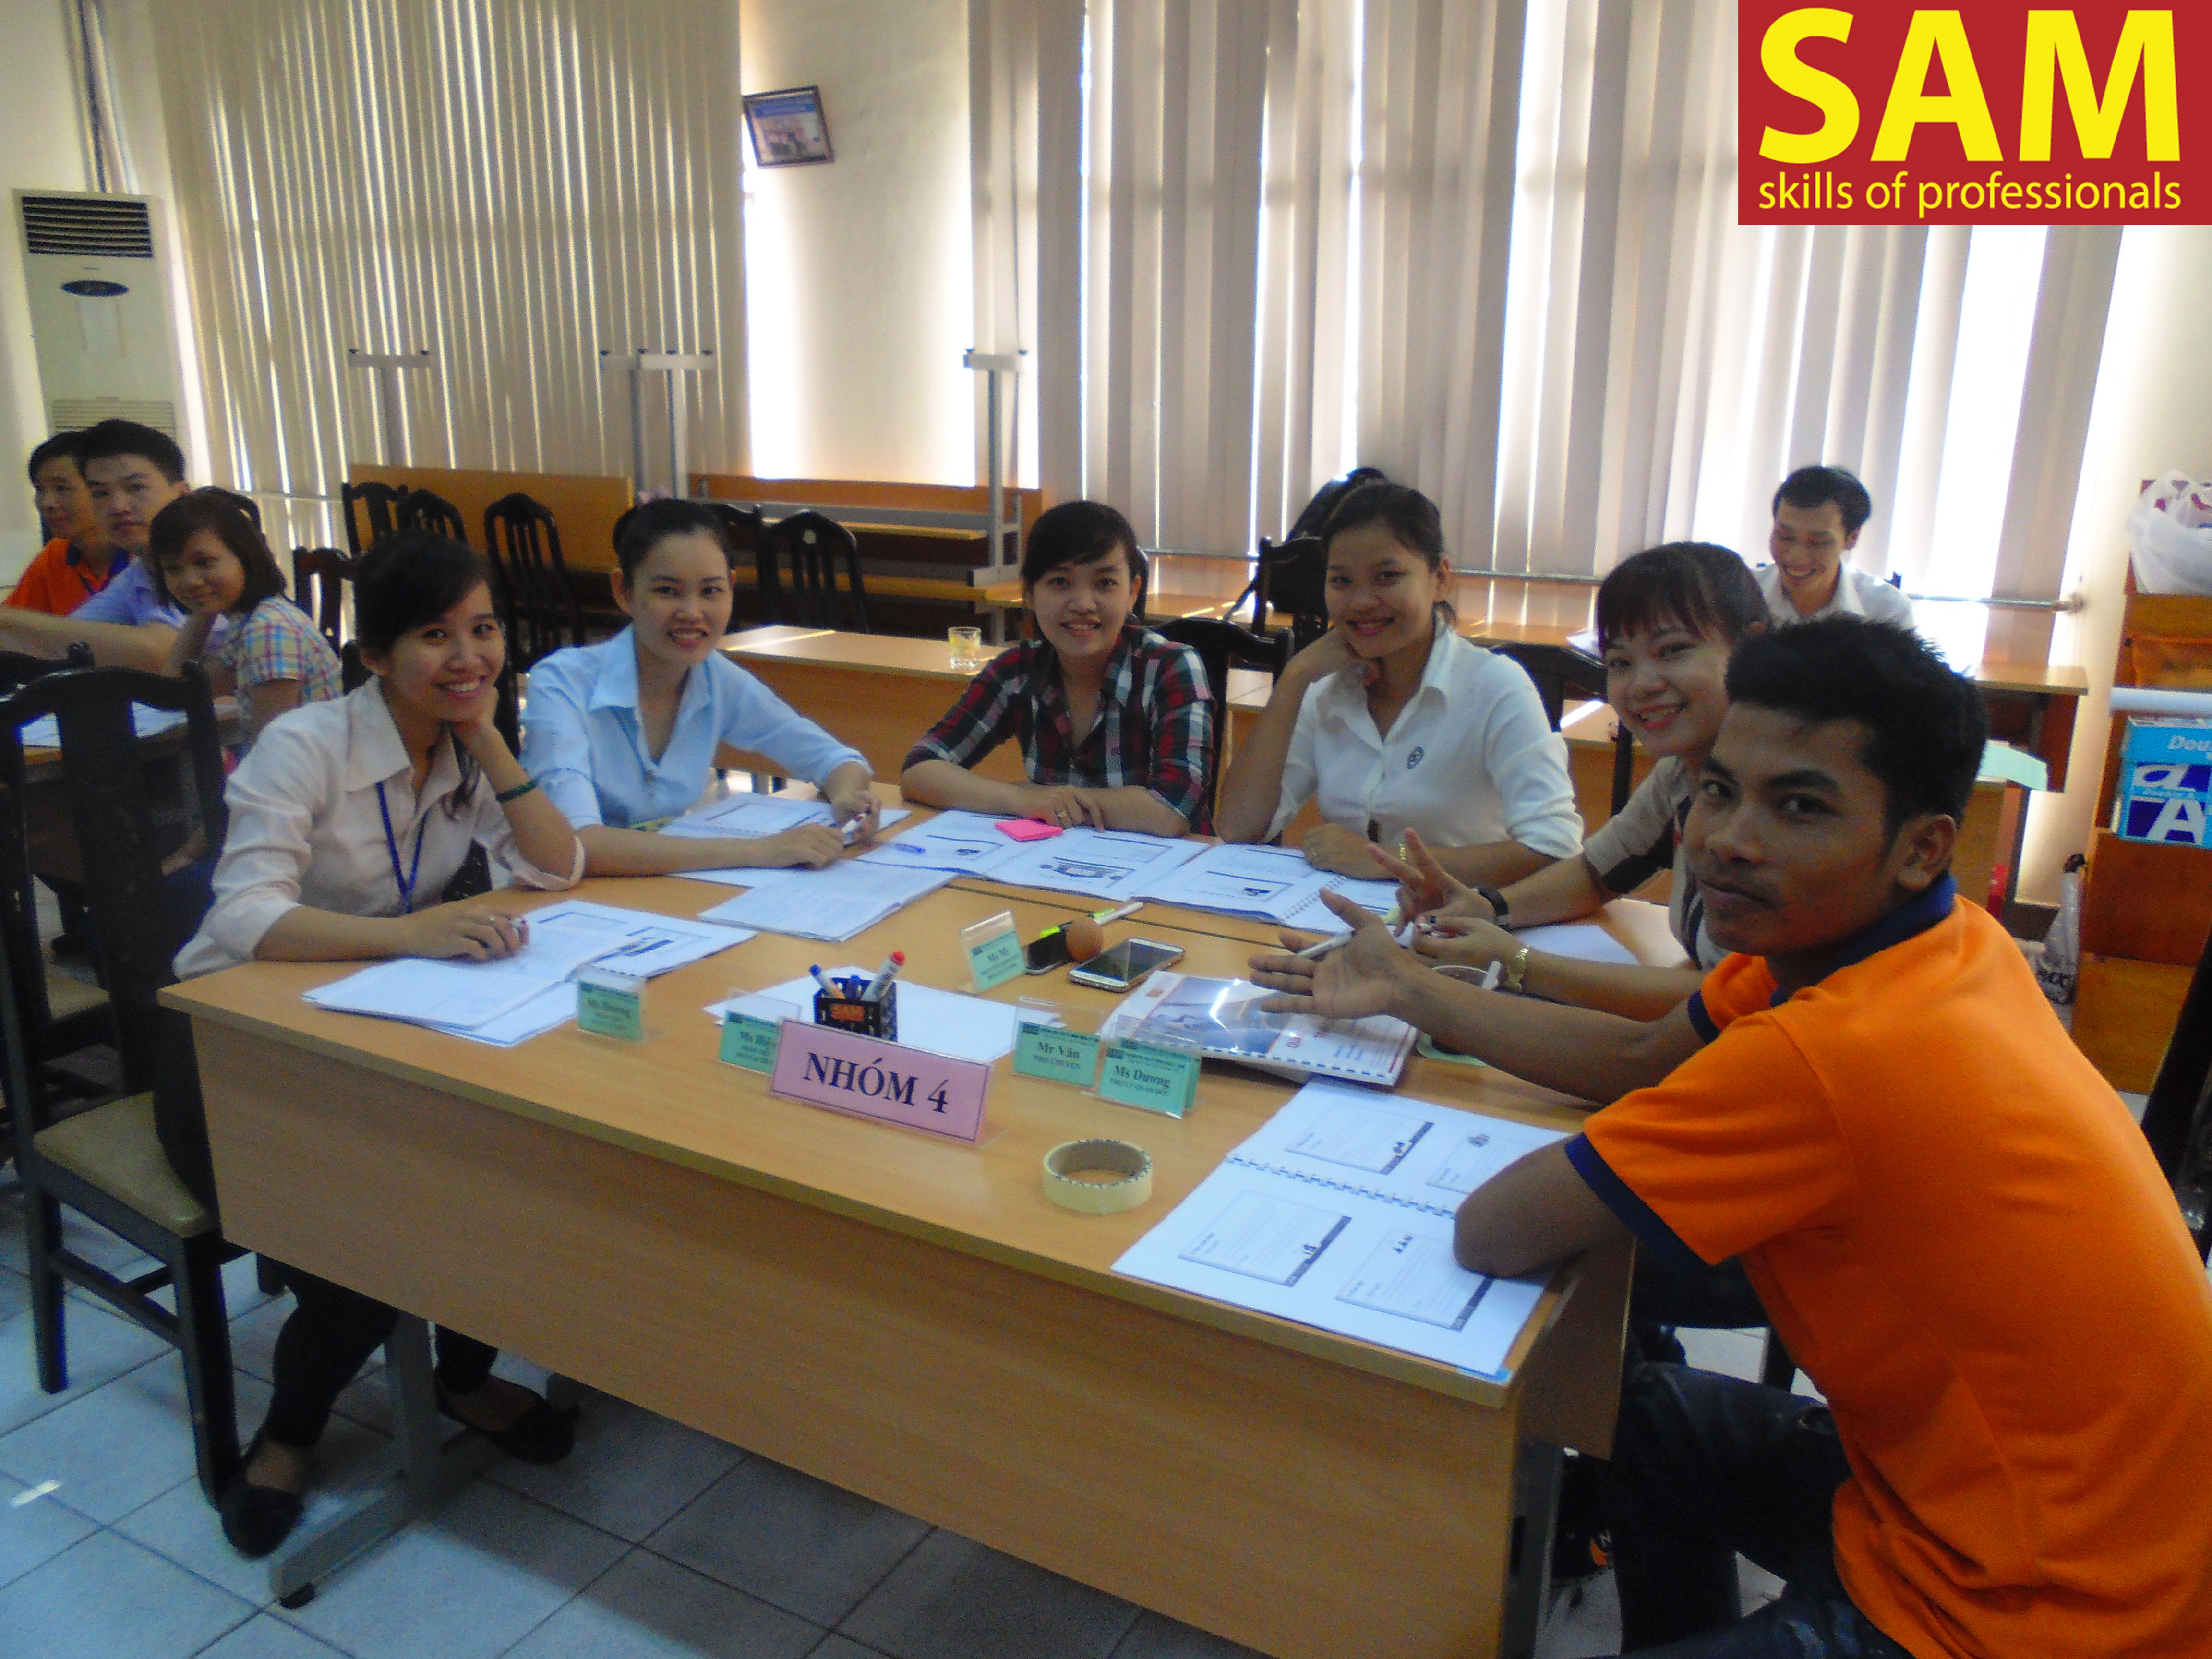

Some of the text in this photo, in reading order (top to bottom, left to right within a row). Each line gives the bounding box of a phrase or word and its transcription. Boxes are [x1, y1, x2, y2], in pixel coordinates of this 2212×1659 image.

[1038, 1042, 1056, 1054] Mr
[1114, 1064, 1130, 1078] Ms
[803, 1052, 918, 1106] NHÓM
[927, 1079, 949, 1114] 4
